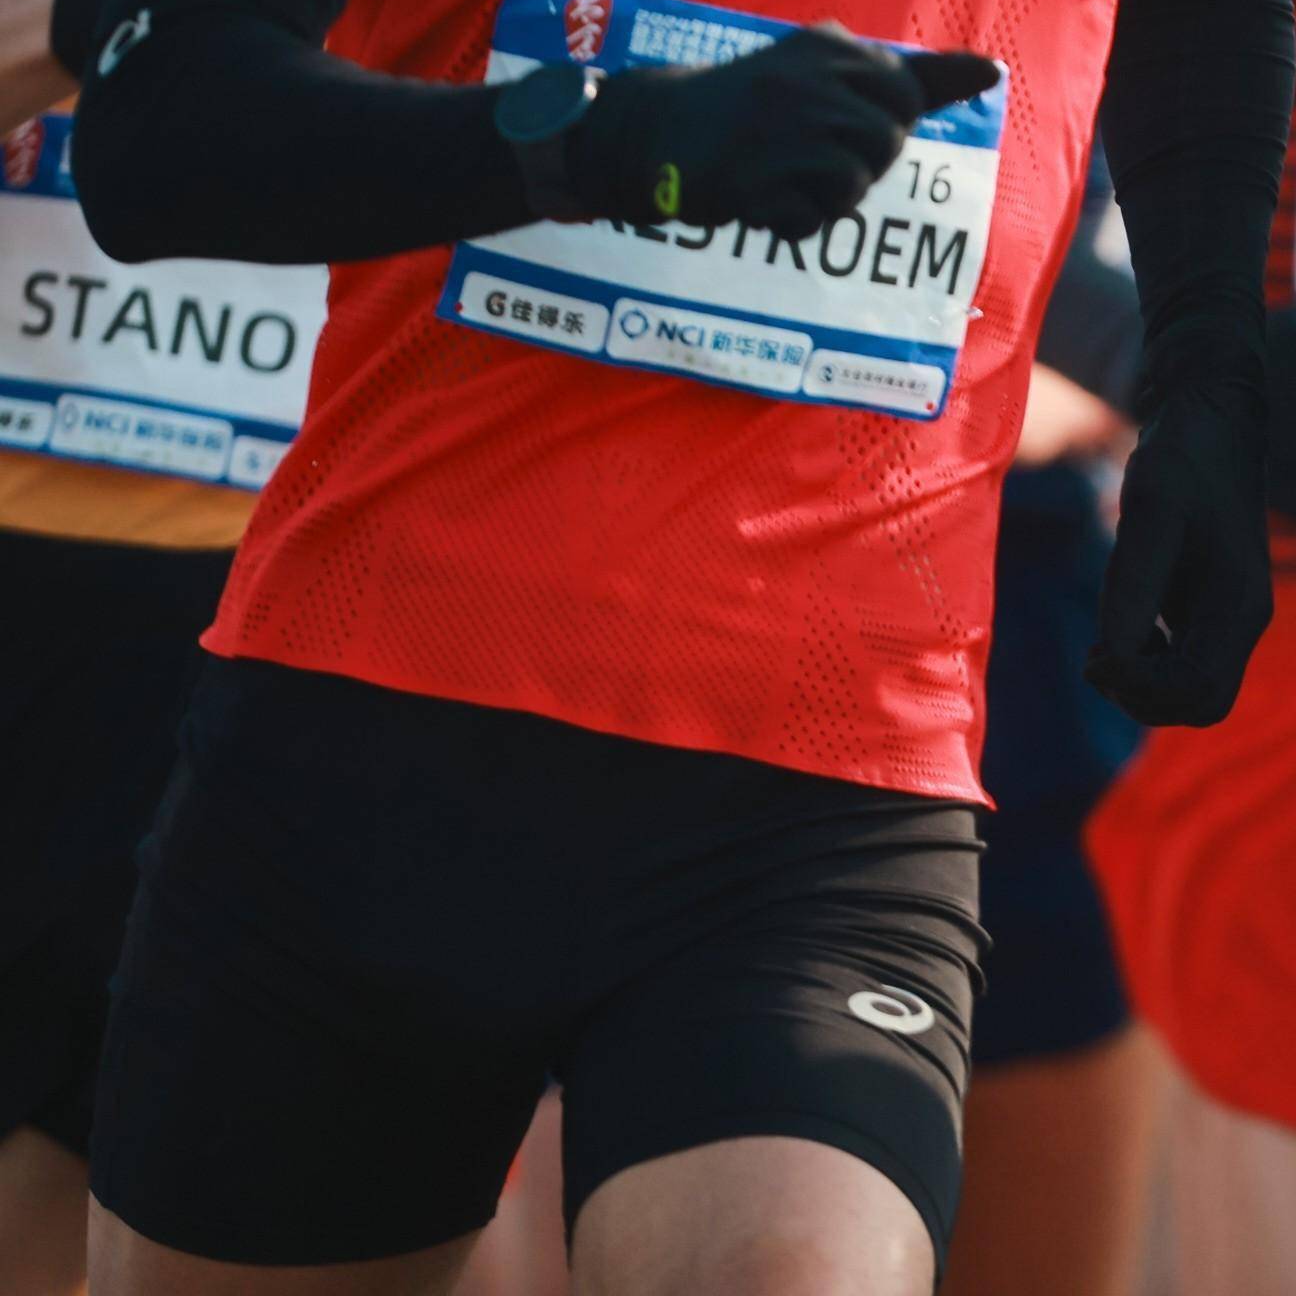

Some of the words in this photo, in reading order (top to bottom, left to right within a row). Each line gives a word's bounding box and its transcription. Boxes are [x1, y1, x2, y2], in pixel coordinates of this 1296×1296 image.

[907, 159, 953, 204] 16
[20, 270, 296, 374] STANO
[655, 319, 706, 347] NCI
